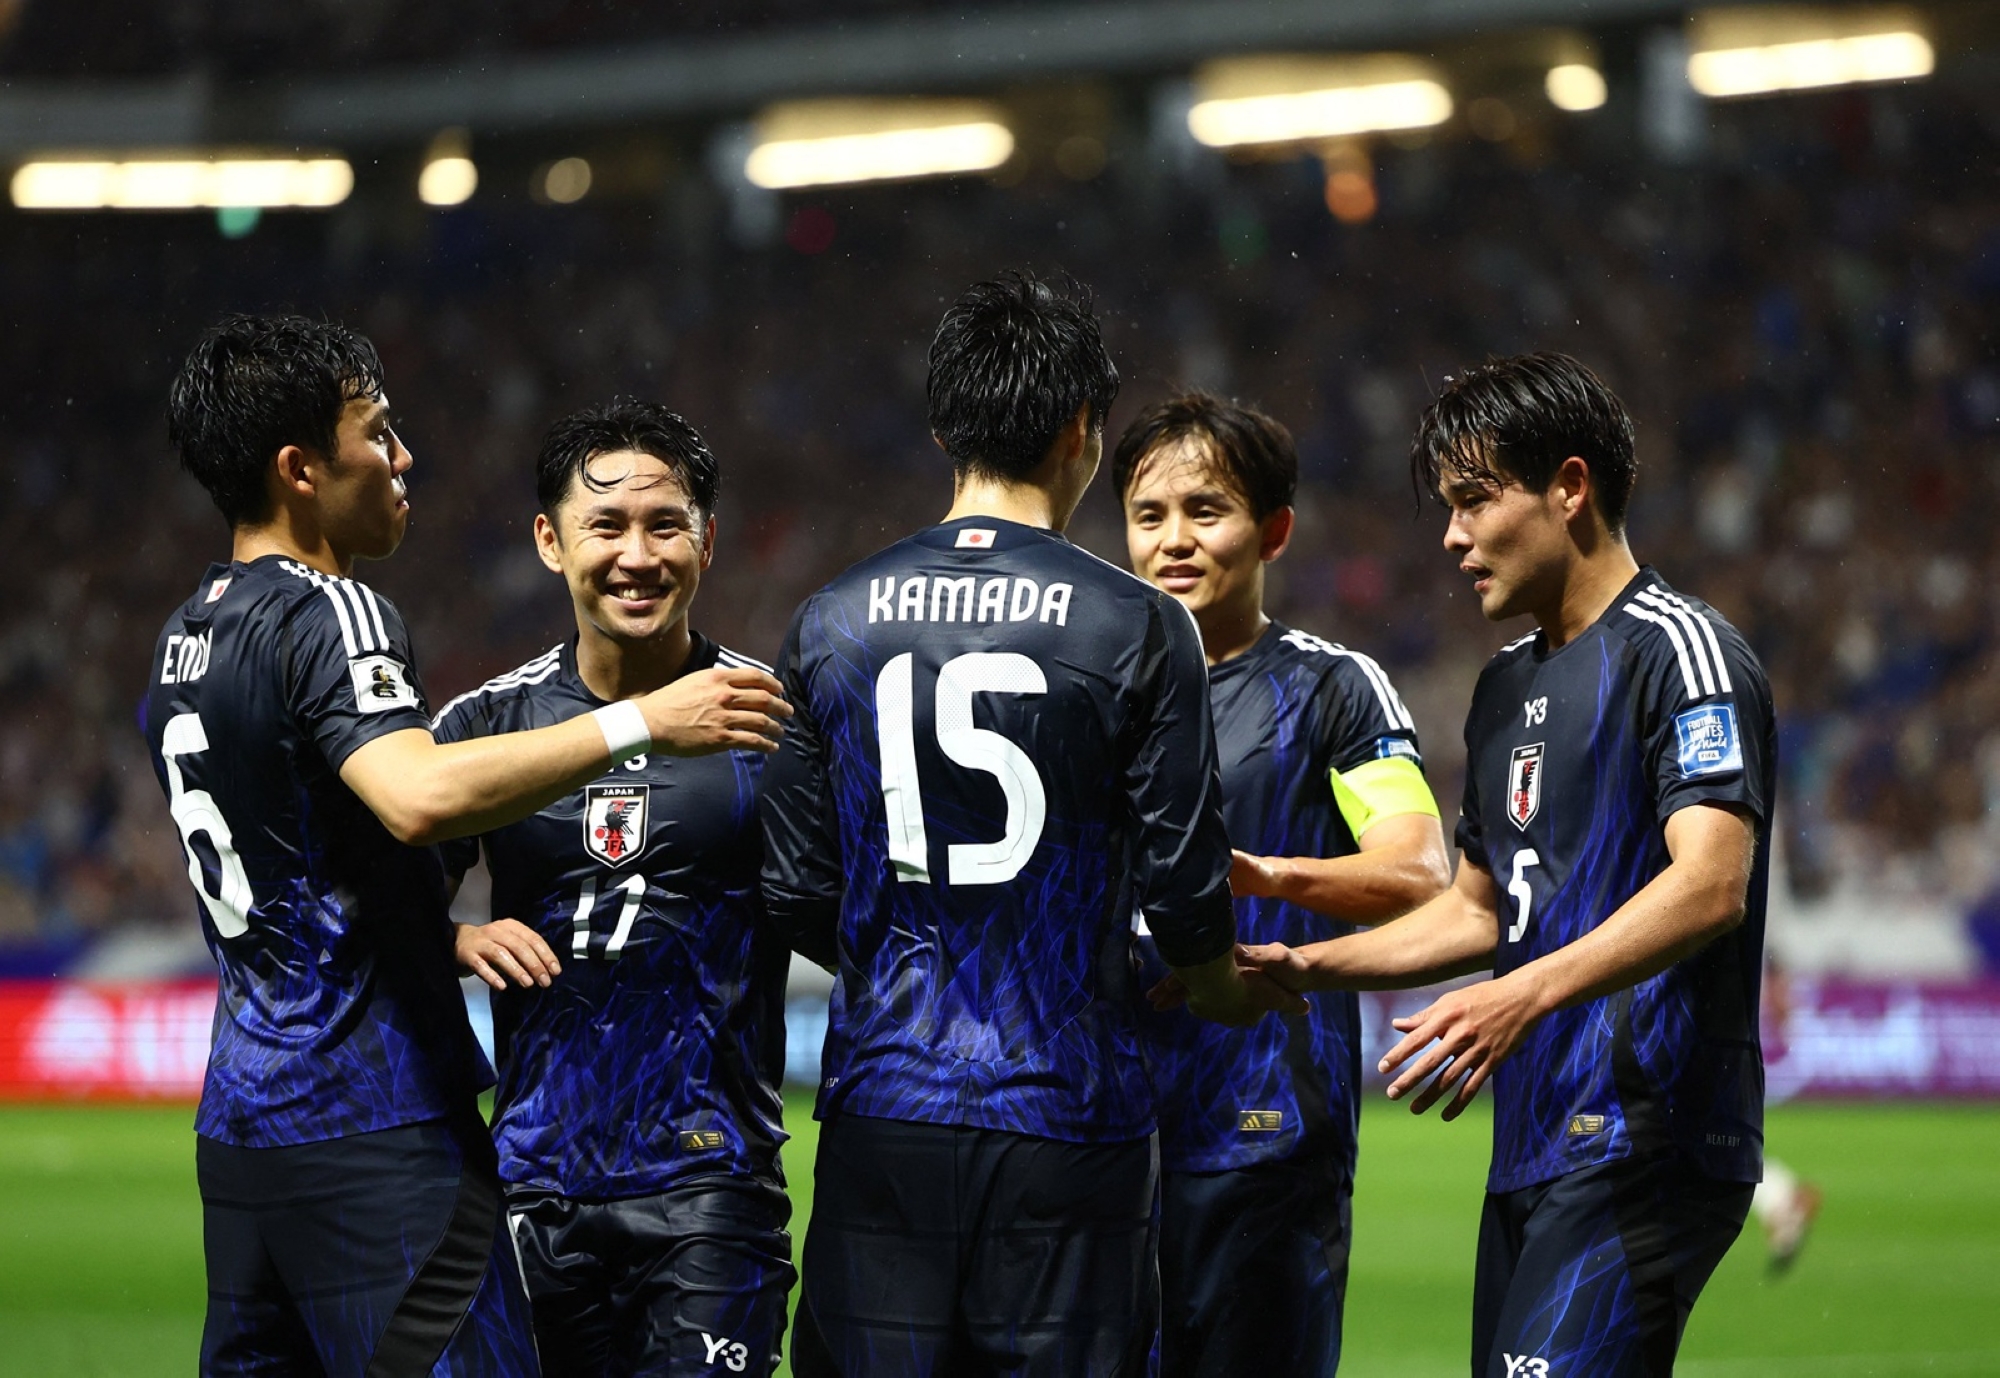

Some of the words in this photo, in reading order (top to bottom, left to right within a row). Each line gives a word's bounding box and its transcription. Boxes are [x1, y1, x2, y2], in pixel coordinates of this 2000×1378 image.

[868, 576, 1073, 627] KAMADA
[1524, 696, 1548, 728] Y-3
[876, 652, 1048, 886] 15
[602, 788, 635, 796] JAPAN
[162, 712, 254, 939] 6
[601, 840, 628, 852] JFA
[572, 874, 646, 961] 17
[1508, 848, 1540, 942] 5
[701, 1332, 749, 1372] Y-3
[1502, 1352, 1550, 1378] Y-3
